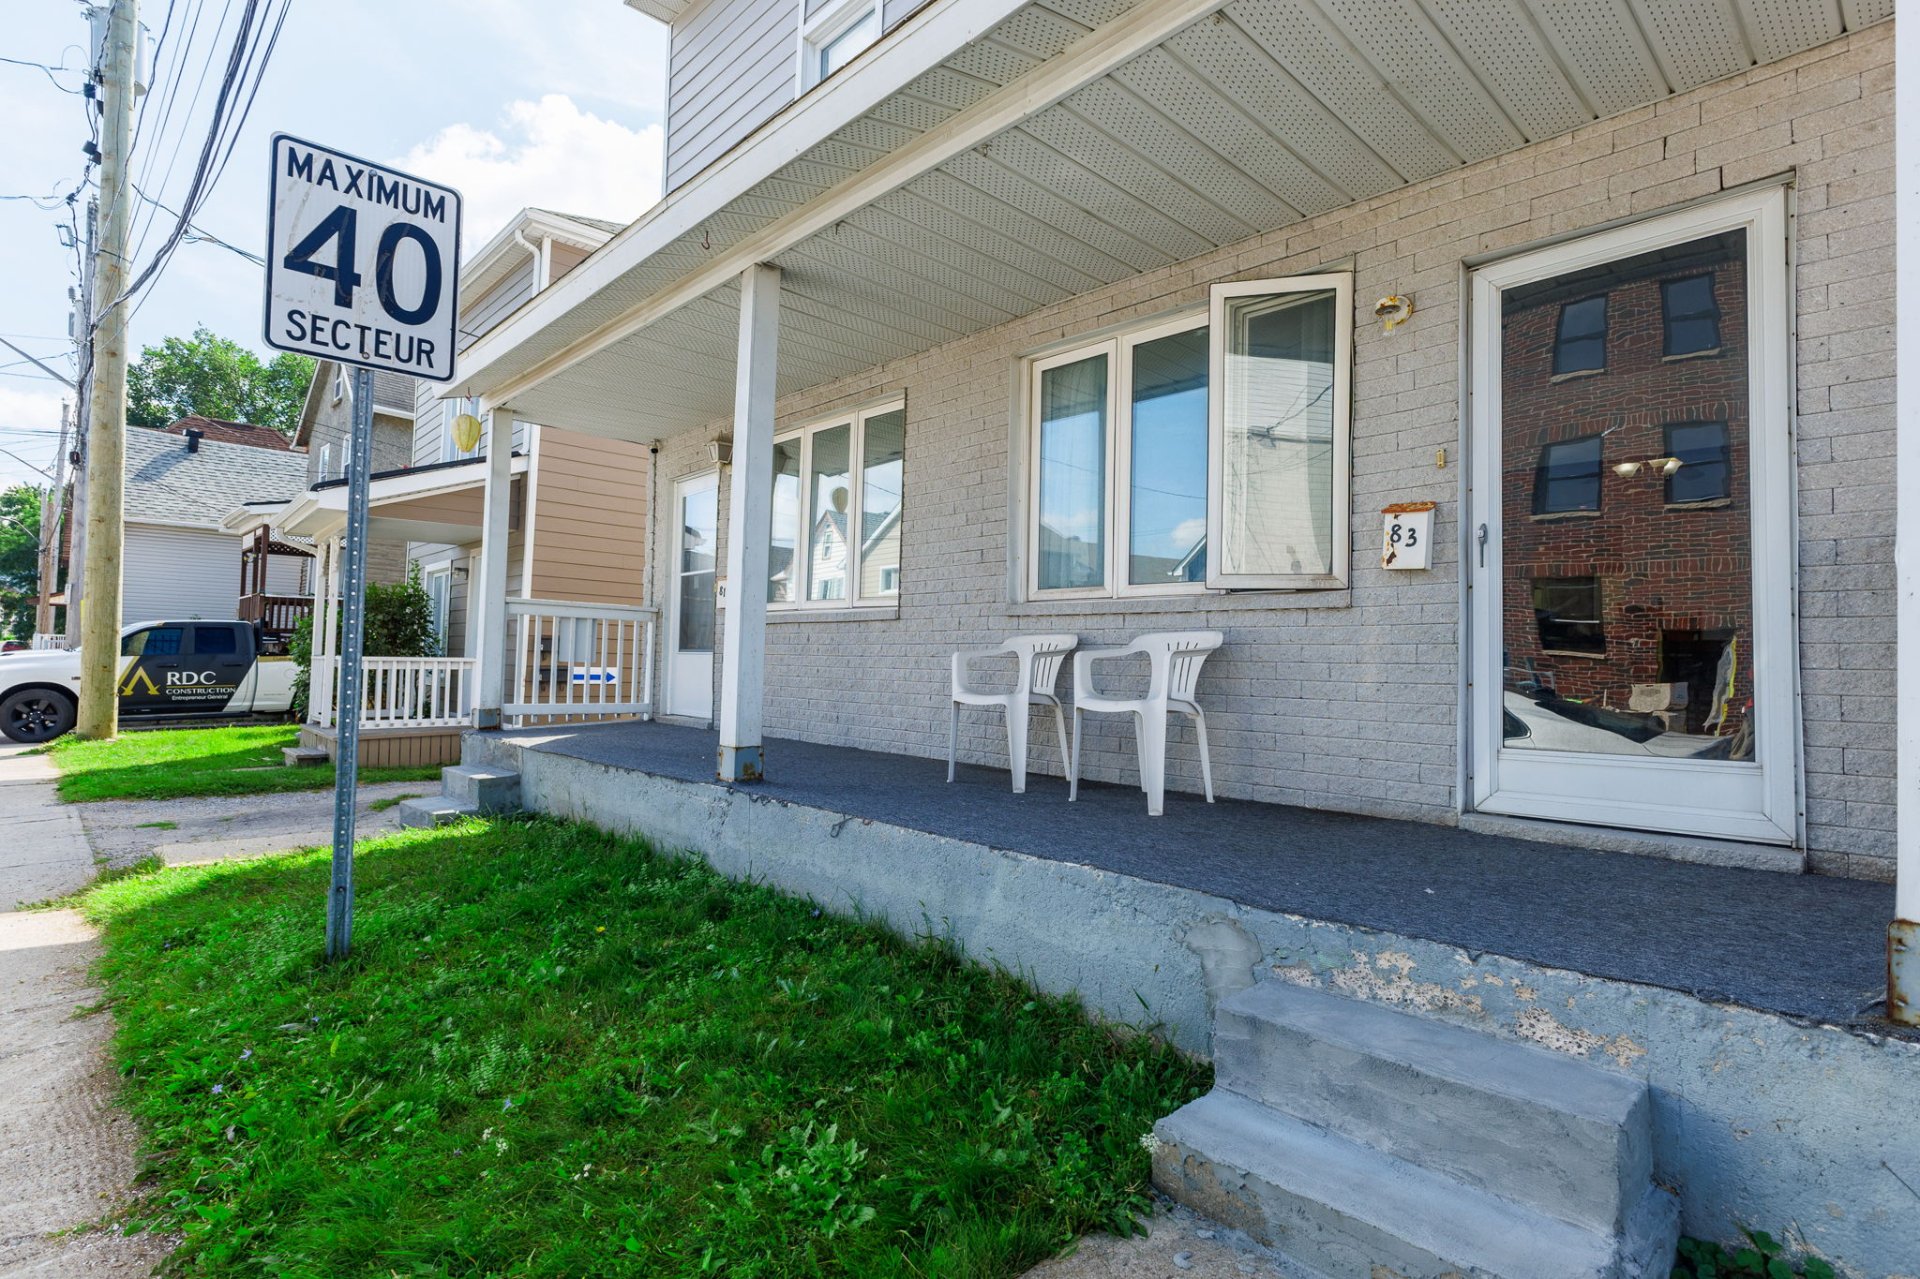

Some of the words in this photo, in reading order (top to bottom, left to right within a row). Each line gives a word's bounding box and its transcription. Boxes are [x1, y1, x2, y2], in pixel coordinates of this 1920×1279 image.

[287, 146, 446, 224] MAXIMUM
[283, 204, 442, 326] 40
[285, 309, 436, 369] SECTEUR
[1390, 523, 1417, 547] 83
[166, 671, 217, 685] RDC
